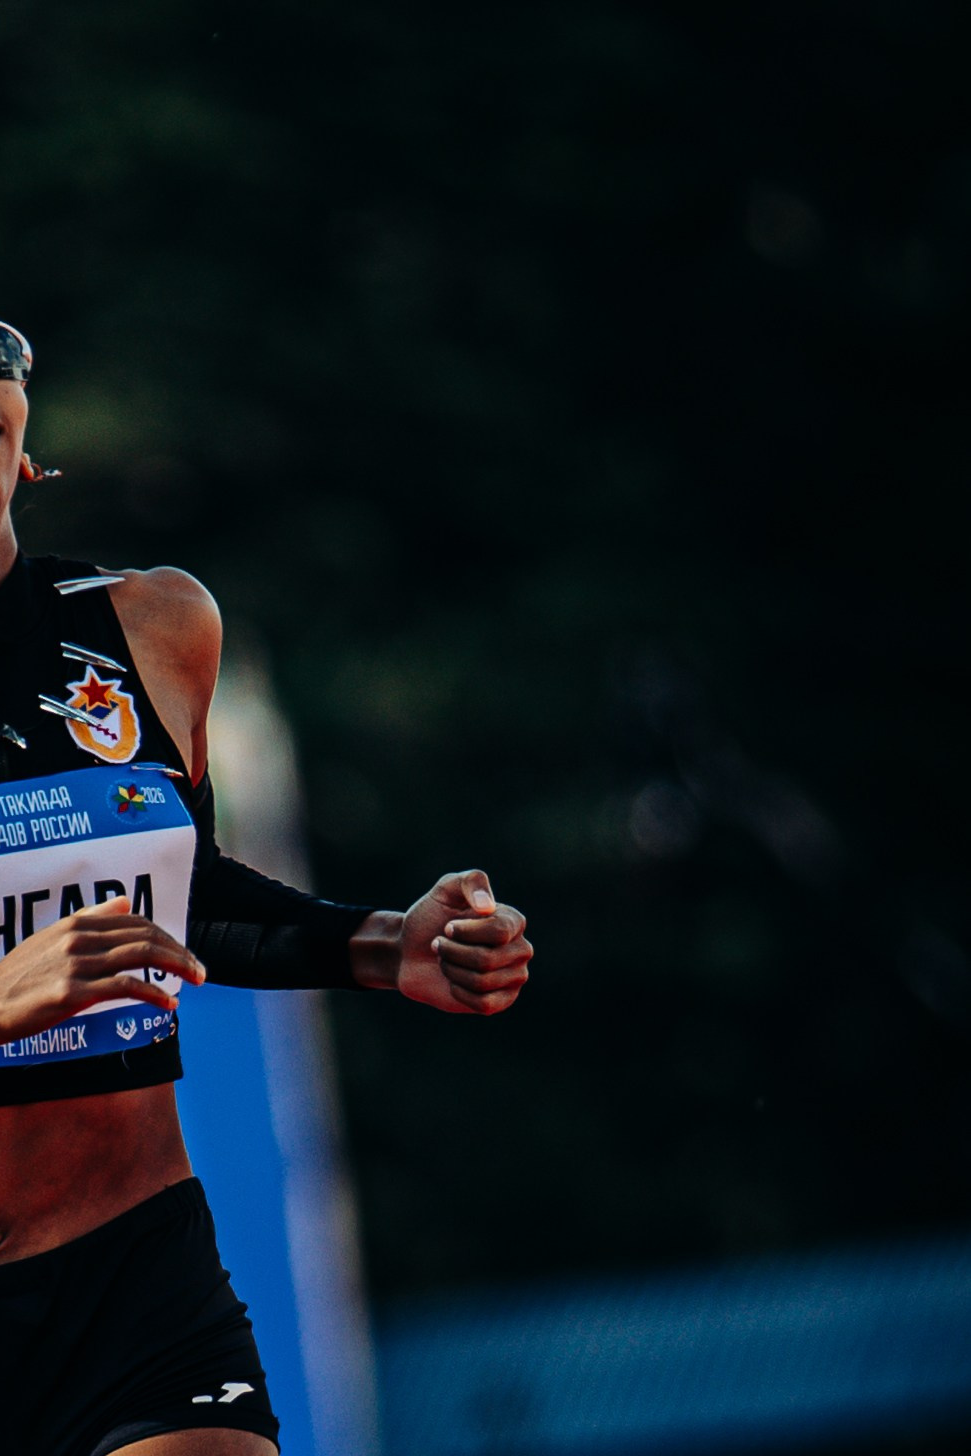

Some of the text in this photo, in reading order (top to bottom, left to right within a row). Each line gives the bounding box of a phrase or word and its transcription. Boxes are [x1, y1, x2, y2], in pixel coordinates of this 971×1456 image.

[140, 786, 166, 804] 2026
[30, 811, 93, 843] РОССИИ
[142, 1009, 174, 1031] ВФЛ
